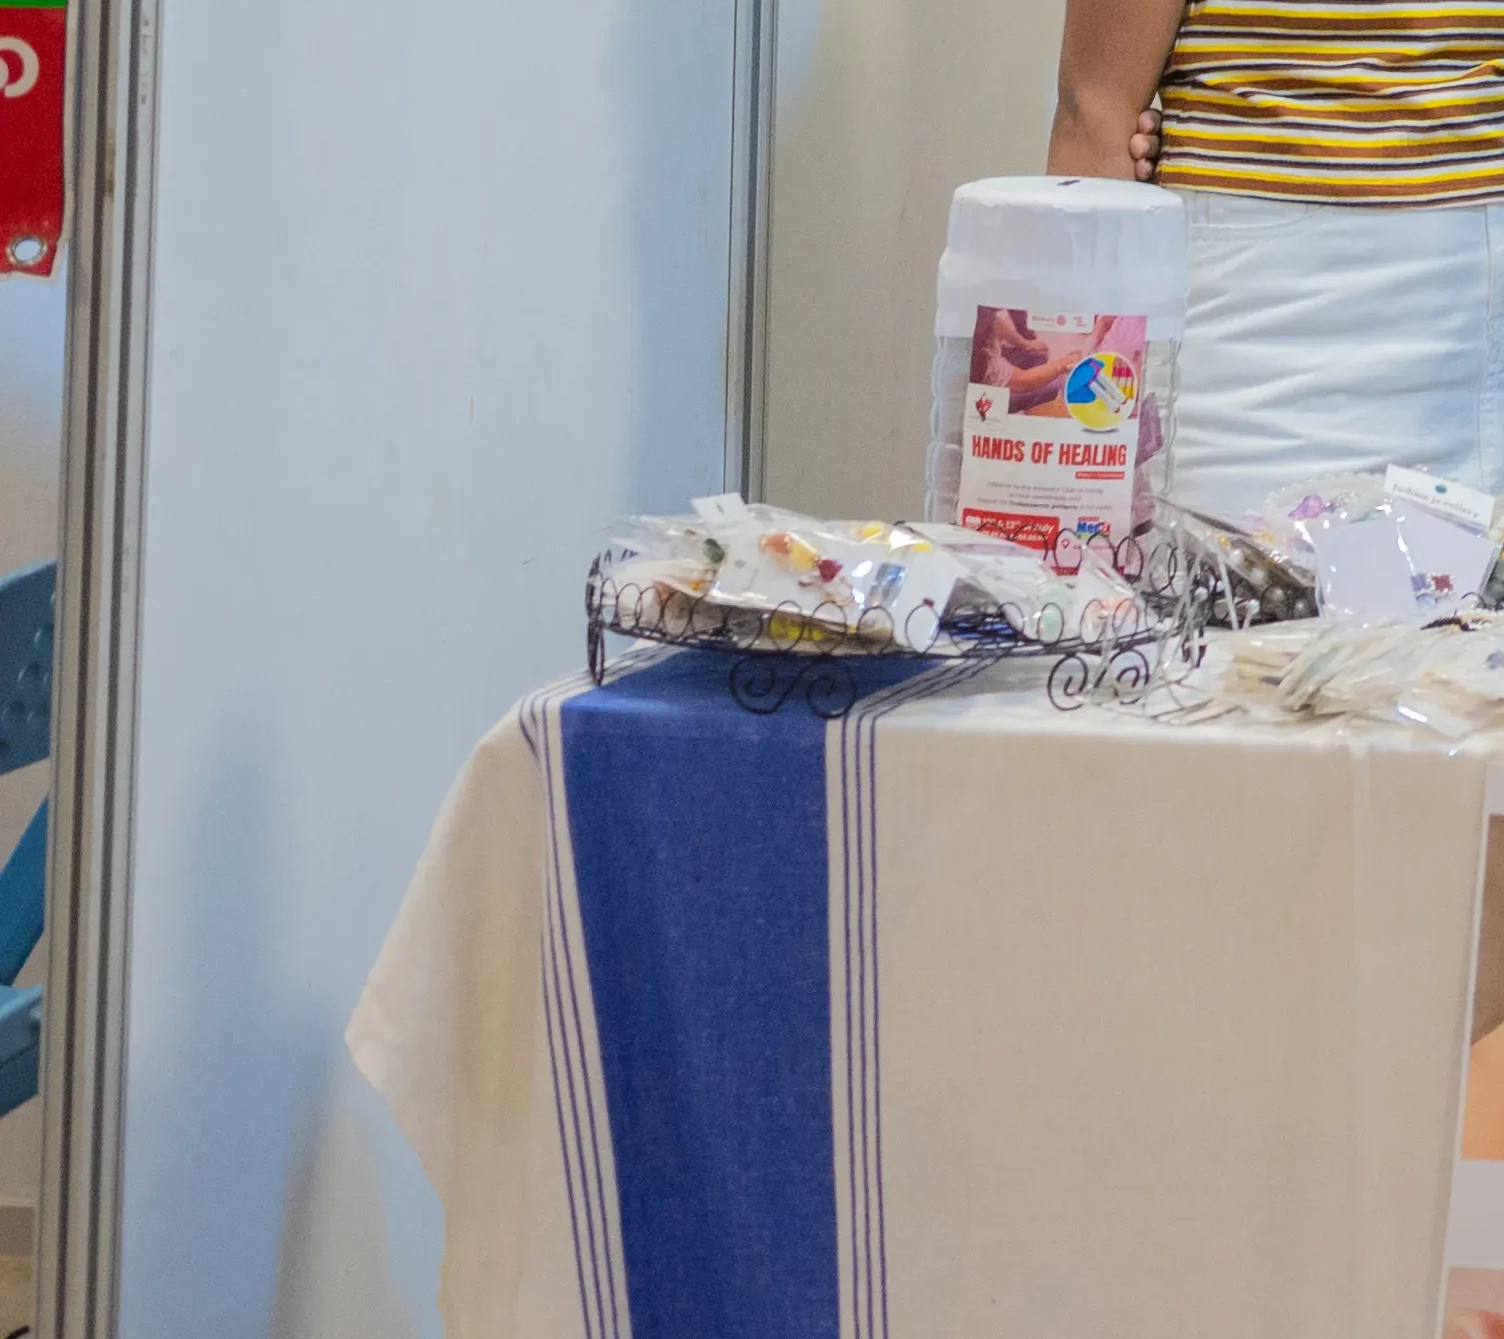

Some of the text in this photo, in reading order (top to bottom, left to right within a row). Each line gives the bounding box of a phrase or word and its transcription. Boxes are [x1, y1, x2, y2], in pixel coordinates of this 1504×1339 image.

[972, 435, 1128, 467] HANDS OF HEALING
